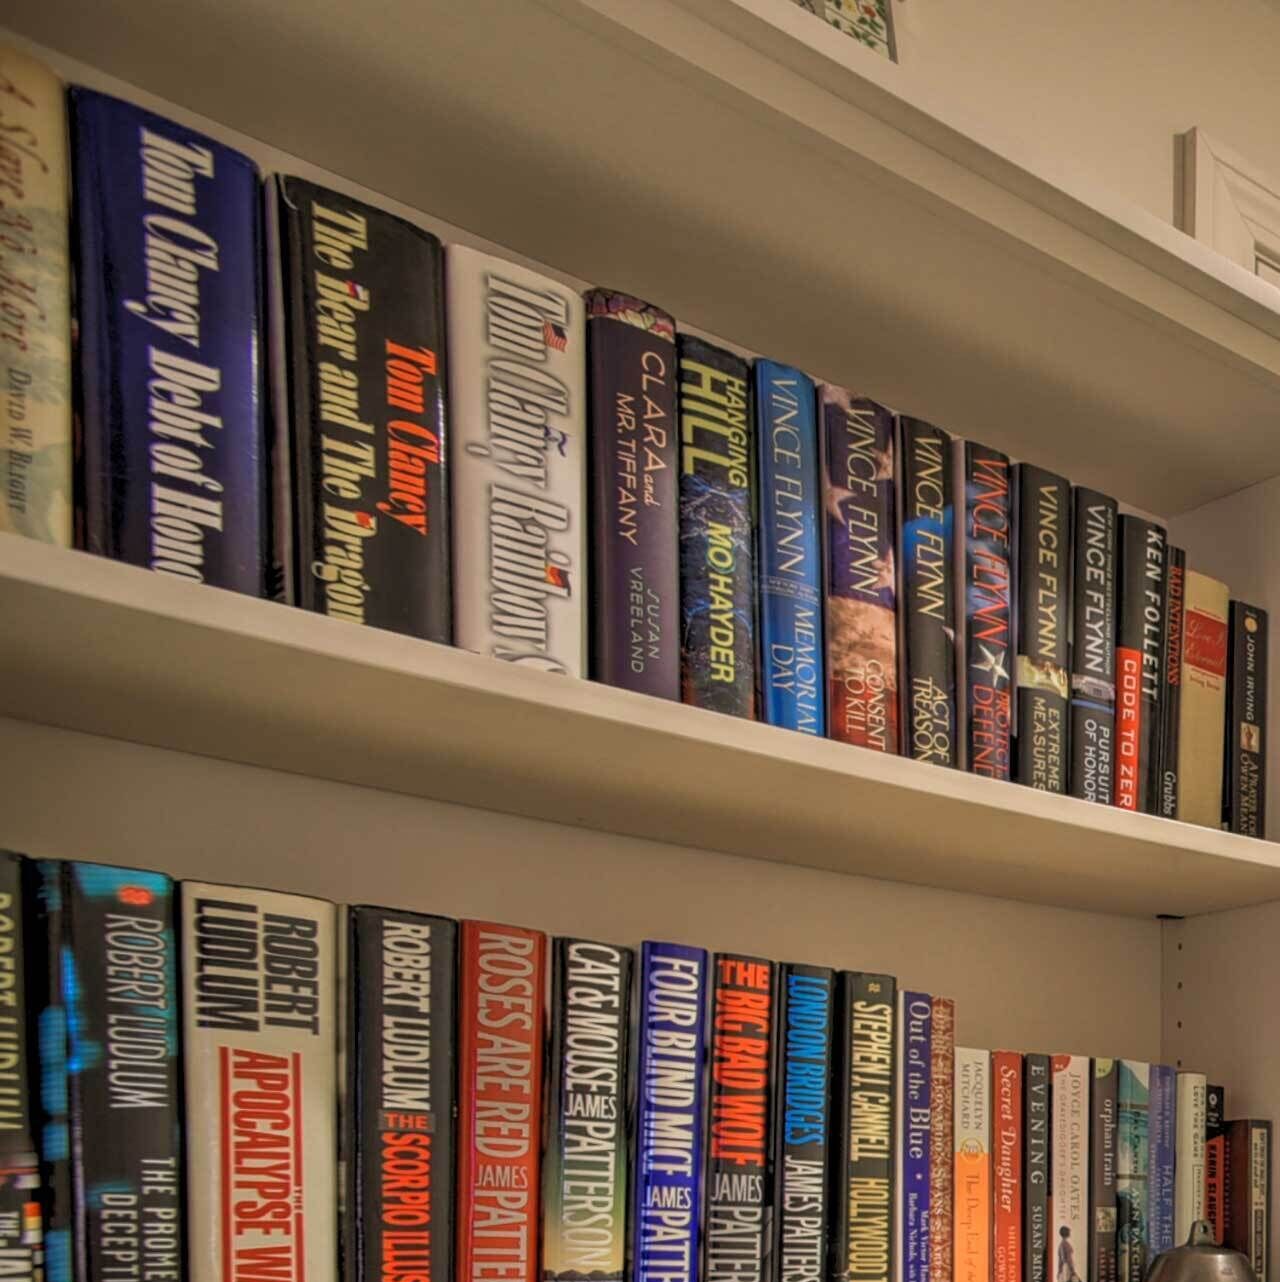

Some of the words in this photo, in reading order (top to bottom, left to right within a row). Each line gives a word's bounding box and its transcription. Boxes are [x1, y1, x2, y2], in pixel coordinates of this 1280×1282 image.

[139, 127, 213, 215] Tom
[311, 200, 368, 270] The
[123, 214, 219, 347] Clancy
[315, 271, 370, 361] Bear
[149, 347, 222, 449] Debt
[320, 362, 375, 434] and
[384, 340, 437, 414] Tom
[641, 350, 665, 467] CLARA
[615, 392, 635, 435] MR.
[680, 358, 726, 475] HILL
[726, 376, 748, 489] HANGING
[770, 376, 800, 474] VINCE
[151, 443, 223, 491] of
[322, 434, 376, 500] The
[376, 419, 440, 535] Clancy
[616, 436, 639, 546] TIFFANY
[643, 471, 660, 507] and
[707, 521, 733, 569] MO
[770, 478, 804, 582] FLYNN
[1037, 484, 1058, 571] VINCE
[1085, 506, 1107, 591] VINCE
[1145, 530, 1163, 582] KEN
[311, 503, 378, 624] Dragon
[1171, 567, 1181, 597] BAD
[629, 566, 643, 674] VREELAND
[645, 589, 660, 659] SUSAN
[709, 574, 735, 683] HAYDER
[1037, 577, 1057, 658] FLYNN
[1084, 592, 1106, 674] FLYNN
[1141, 588, 1161, 701] FOLLETT
[1168, 601, 1180, 686] INTENTIONS
[770, 643, 794, 692] DAY
[1122, 658, 1138, 719] CODE
[1245, 637, 1255, 676] JOHN
[1084, 719, 1097, 741] OF
[1244, 679, 1255, 721] IRVING
[1032, 697, 1047, 791] MEASURES
[1047, 709, 1060, 791] EXTREME
[1082, 743, 1097, 802] HONOR
[1097, 726, 1109, 804] PURSUIT
[1121, 728, 1136, 758] TO
[1163, 771, 1176, 815] Grubbs
[104, 913, 166, 1011] ROBERT
[194, 899, 259, 1031] LUDLUM
[263, 913, 320, 1035] ROBERT
[478, 931, 533, 1029] ROSES
[649, 956, 699, 1025] FOUR
[852, 1001, 892, 1066] STEPHEN
[909, 1001, 931, 1042] Out
[909, 1049, 928, 1064] of
[108, 1013, 169, 1110] LUDLUM
[477, 1031, 531, 1093] ARE
[647, 1031, 697, 1109] BLIND
[852, 1068, 891, 1087] J.
[909, 1073, 928, 1099] the
[960, 1063, 971, 1130] MITCHARD
[972, 1060, 984, 1131] JACQUELYN
[999, 1065, 1016, 1121] Secret
[1069, 1072, 1082, 1117] JOYCE
[232, 1049, 294, 1236] APOCALYPSE
[475, 1099, 529, 1158] RED
[644, 1112, 693, 1176] MICE
[849, 1089, 891, 1162] CANNELL
[909, 1107, 931, 1158] Blue
[1031, 1064, 1044, 1185] EVENING
[1069, 1122, 1082, 1170] CAROL
[1099, 1098, 1116, 1149] orphan
[141, 1156, 176, 1195] THE
[475, 1164, 528, 1188] JAMES
[647, 1184, 691, 1209] JAMES
[997, 1127, 1016, 1212] Daughter
[1069, 1174, 1082, 1221] OATES
[1103, 1152, 1116, 1186] train
[1160, 1165, 1173, 1207] HALF
[849, 1177, 890, 1274] HOLLYWOOD
[1031, 1205, 1043, 1248] SUSAN
[1160, 1214, 1173, 1245] THE
